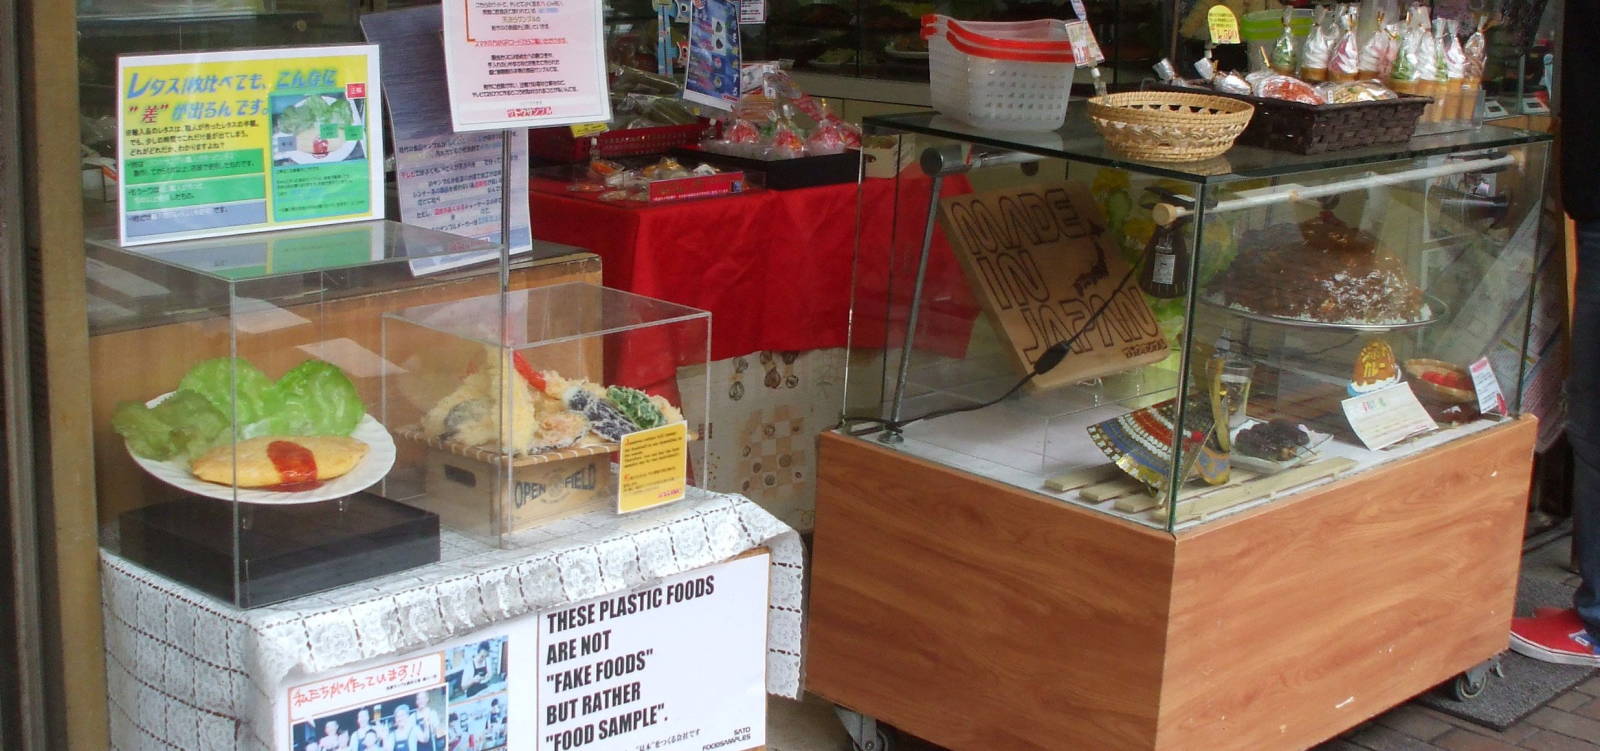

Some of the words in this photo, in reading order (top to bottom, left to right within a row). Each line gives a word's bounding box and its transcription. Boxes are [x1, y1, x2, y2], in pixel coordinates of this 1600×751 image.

[951, 188, 1086, 255] MADE
[976, 250, 1049, 310] IN
[1020, 286, 1159, 365] JAPAN
[514, 481, 546, 509] OPEN
[562, 464, 596, 489] FIELD
[547, 603, 595, 634] THESE
[600, 588, 663, 622] PLASTIC
[666, 575, 715, 605] FOODS
[546, 639, 577, 665] ARE
[581, 629, 612, 656] NOT
[546, 664, 592, 694] "FAKE
[596, 648, 654, 682] FOODS"
[546, 698, 578, 726] BUT
[582, 681, 641, 716] RATHER
[546, 724, 594, 751] "FOOD
[598, 703, 668, 740] SAMPLE".
[702, 734, 751, 751] FOODSAMPLES
[733, 727, 751, 736] SATO
